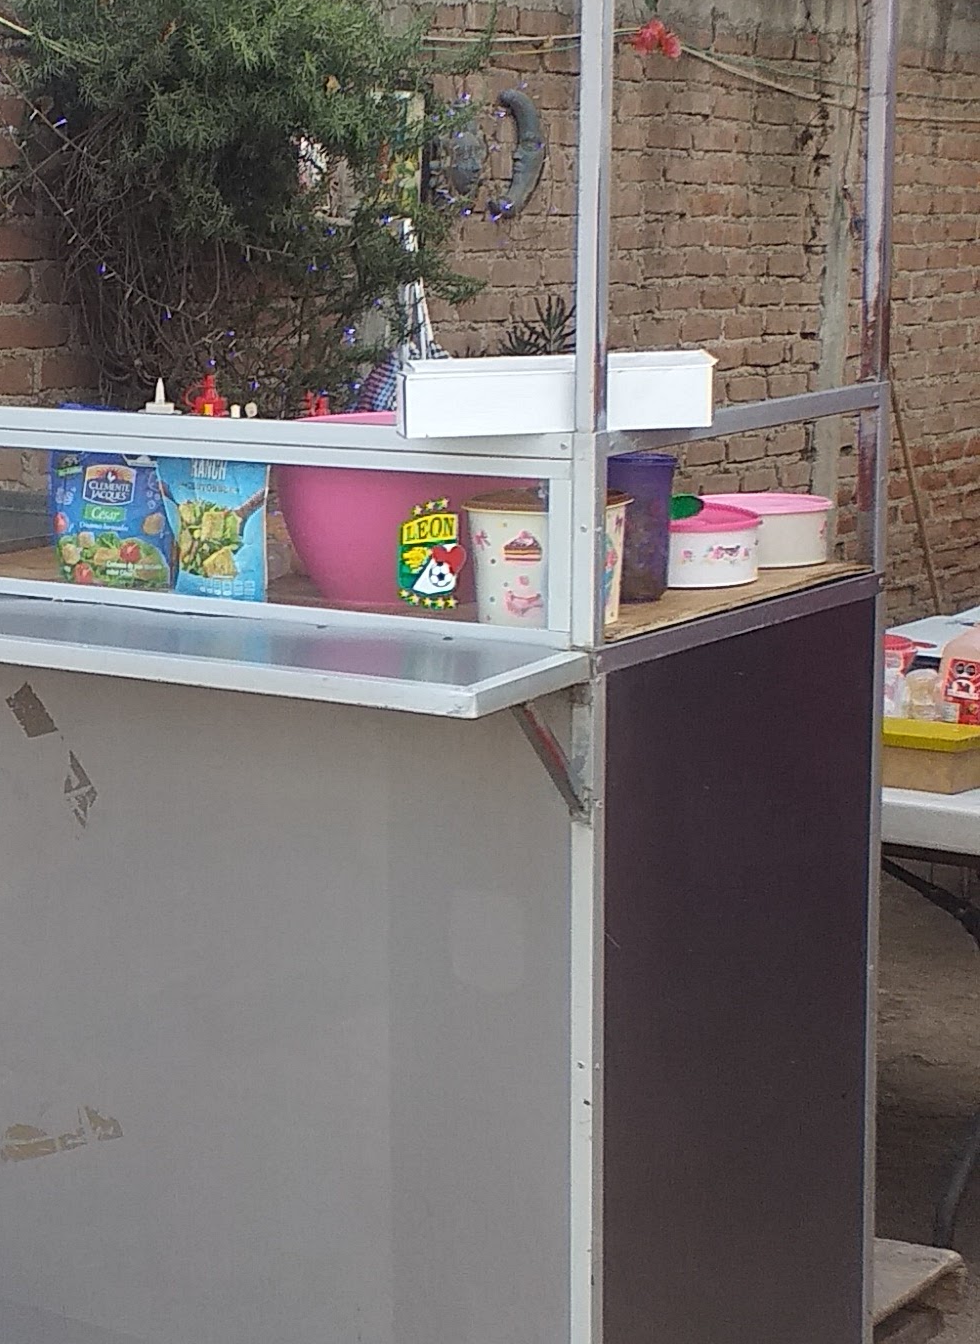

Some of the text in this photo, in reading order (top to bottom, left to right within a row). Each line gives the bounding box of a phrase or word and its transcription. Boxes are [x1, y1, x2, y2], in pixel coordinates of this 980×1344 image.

[191, 458, 228, 481] RANCH
[88, 480, 131, 492] CLEMENTE
[91, 490, 128, 503] JACQUES
[406, 517, 455, 541] LEON
